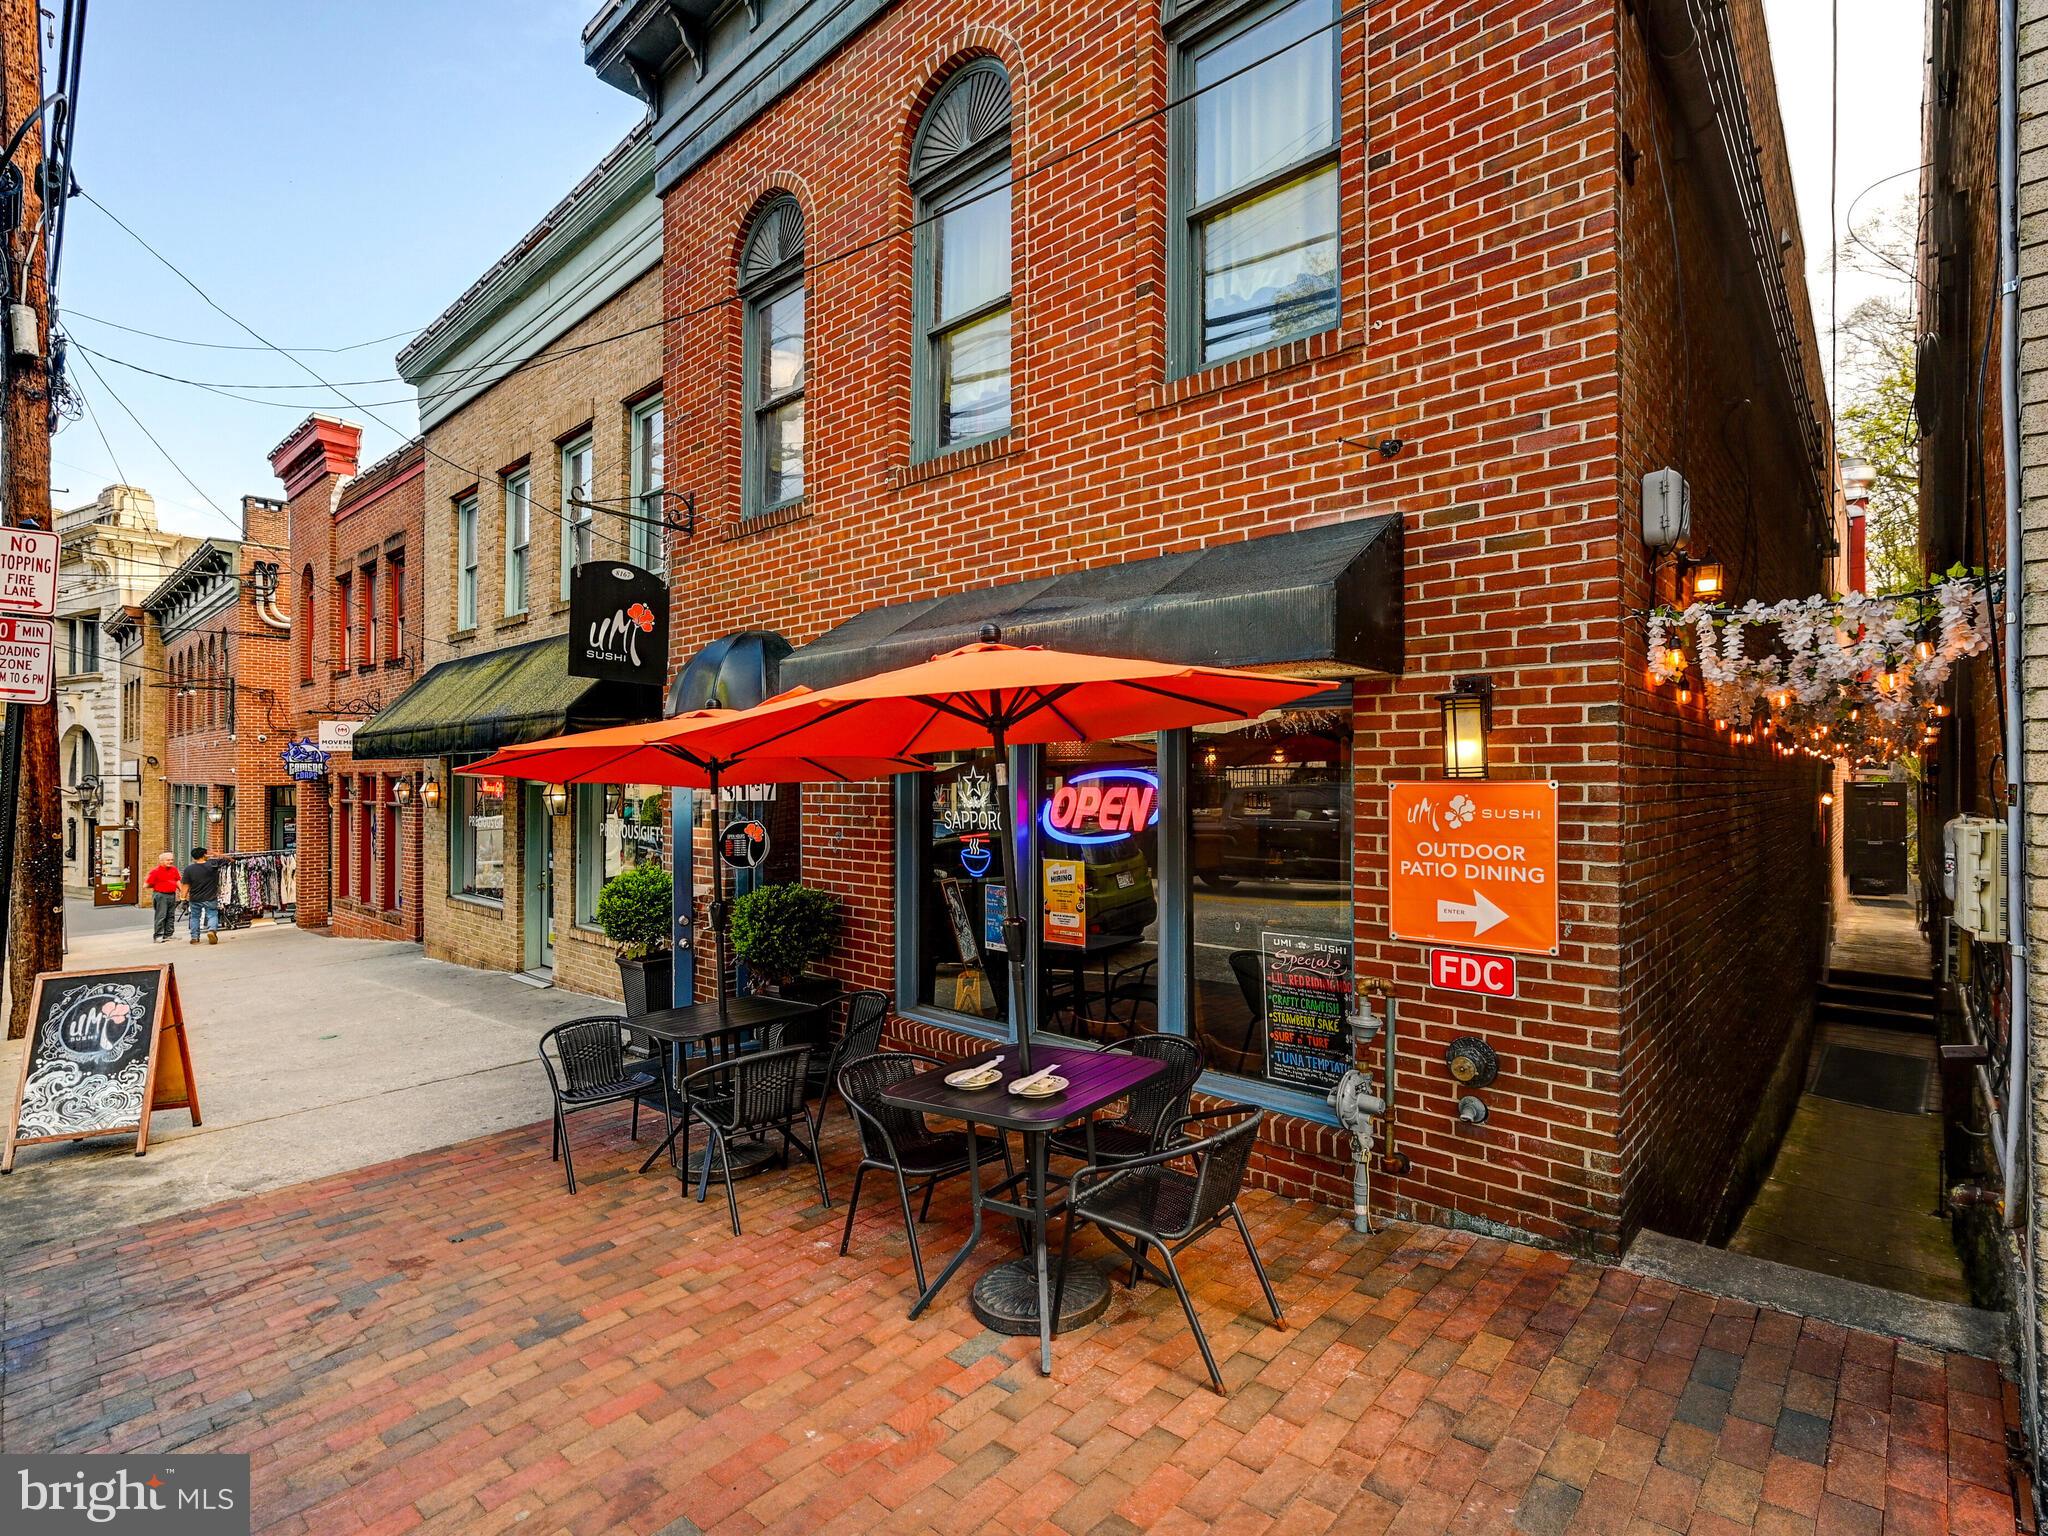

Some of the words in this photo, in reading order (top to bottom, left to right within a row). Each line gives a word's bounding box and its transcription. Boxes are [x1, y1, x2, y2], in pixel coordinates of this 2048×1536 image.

[10, 536, 37, 553] NO
[0, 553, 52, 574] TOPPING
[7, 573, 35, 586] FIRE
[4, 584, 36, 598] LANE
[22, 626, 44, 638] MIN
[0, 645, 40, 658] OADING
[586, 649, 627, 662] SUSHI
[0, 658, 33, 671] ZONE
[10, 672, 20, 684] TO
[22, 674, 30, 684] 6
[32, 674, 44, 684] PM
[1050, 787, 1153, 831] OPEN
[1482, 808, 1541, 820] SUSHI
[600, 823, 639, 840] PRECIOUS
[1416, 841, 1526, 862] OUTDOOR
[1050, 874, 1073, 883] HIRING
[1400, 860, 1458, 879] PATIO
[1464, 863, 1545, 884] DINING
[1273, 938, 1292, 947] UMI
[1313, 943, 1347, 955] SUSHI
[1271, 948, 1341, 973] Specials
[1288, 974, 1305, 988] RED
[1439, 954, 1505, 991] FDC
[1272, 994, 1299, 1009] CRAFTY
[1300, 998, 1340, 1014] CRAWFISH
[1273, 1012, 1315, 1028] STRAWBERRY
[1274, 1030, 1295, 1042] SURF
[1305, 1035, 1329, 1049] TURF
[1273, 1050, 1305, 1067] TUNA
